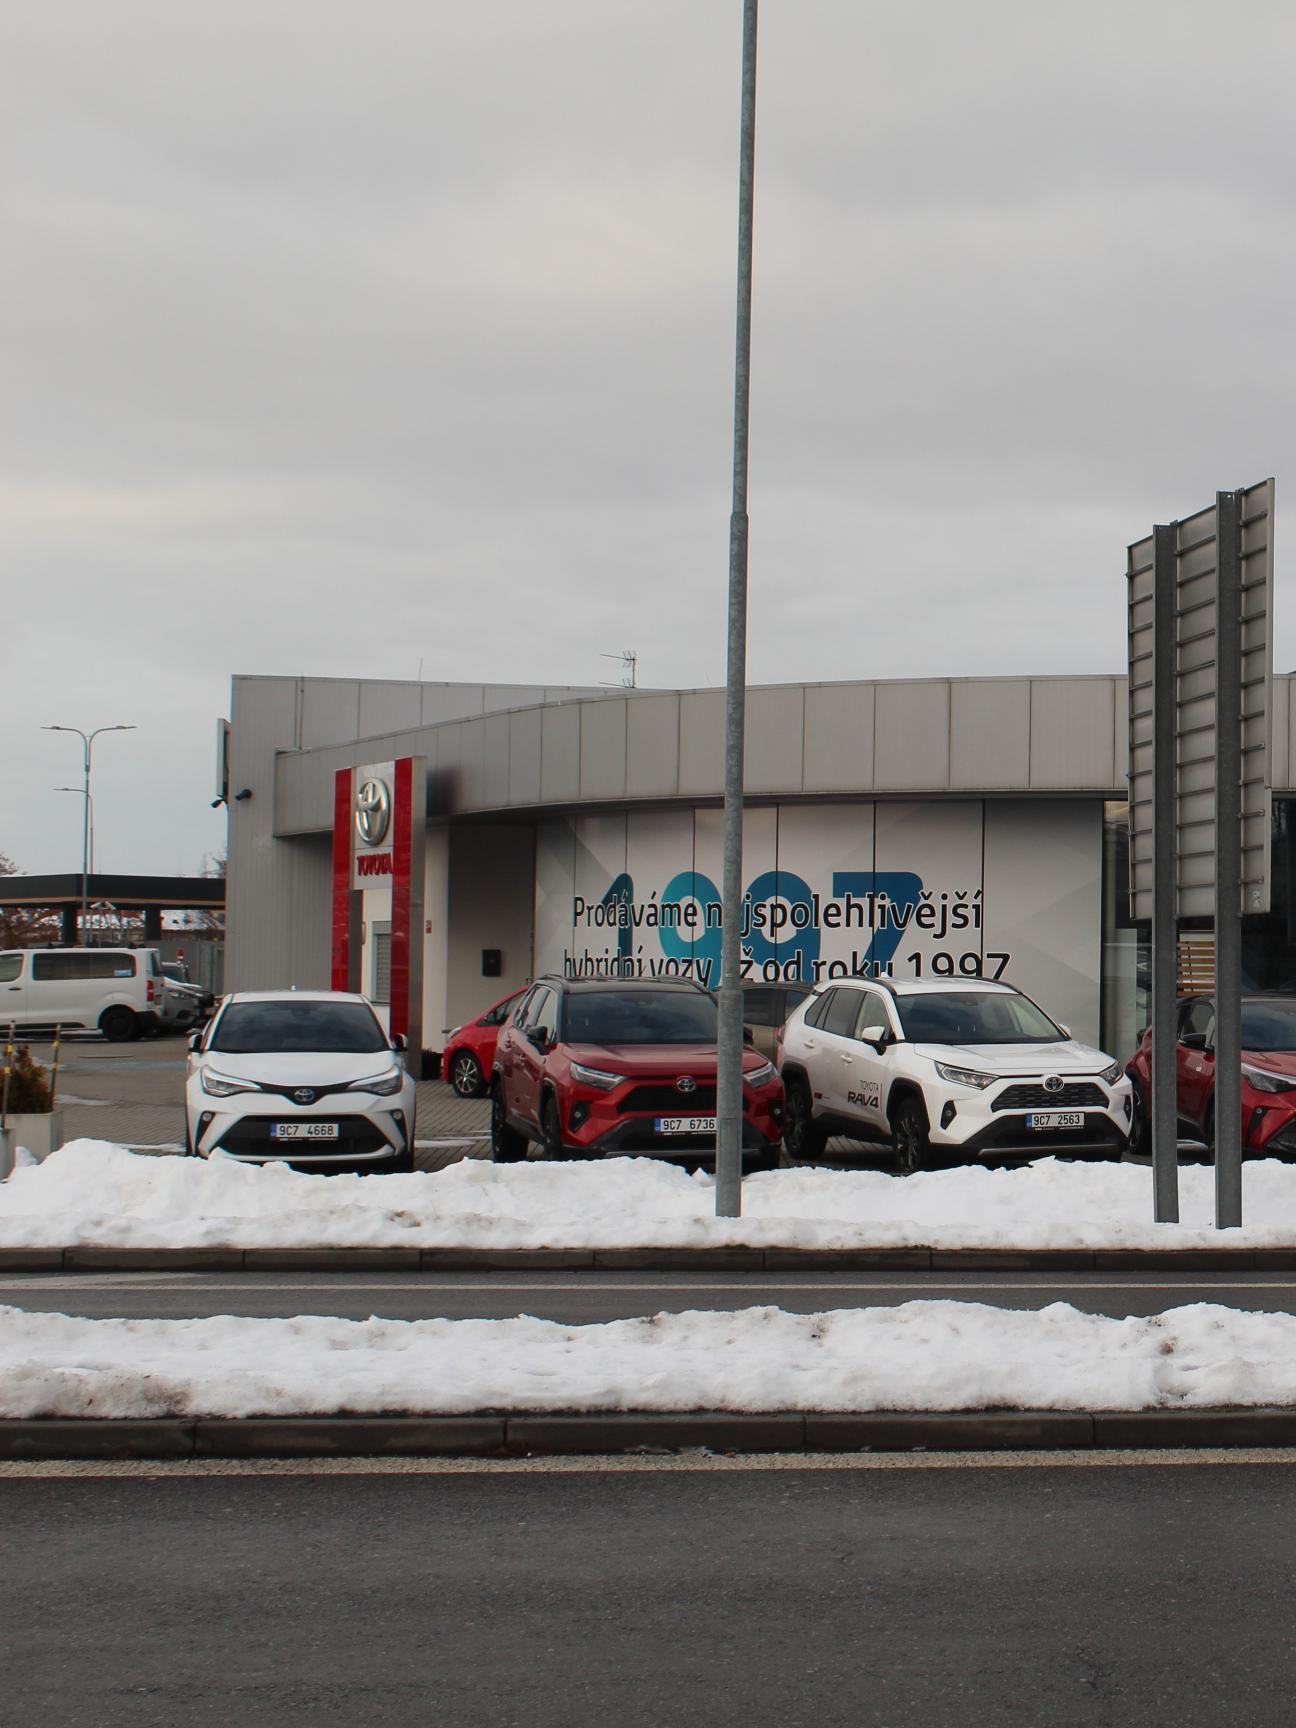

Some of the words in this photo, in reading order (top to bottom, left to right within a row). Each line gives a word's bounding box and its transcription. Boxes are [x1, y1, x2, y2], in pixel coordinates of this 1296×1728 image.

[356, 853, 393, 876] TOYOTA
[574, 889, 698, 928] Prodáváme
[706, 888, 982, 939] njspolehlivější
[650, 956, 713, 987] vozy
[763, 949, 802, 982] od
[813, 951, 894, 982] roku
[908, 951, 1011, 981] 1997
[860, 1079, 879, 1092] TOYOTA
[847, 1091, 879, 1109] RAV4
[663, 1119, 682, 1130] 9C7
[689, 1119, 715, 1130] 6736
[1033, 1115, 1051, 1126] 9C7
[1057, 1114, 1080, 1125] 2563
[279, 1125, 299, 1136] 9C7
[307, 1125, 334, 1136] 4668
